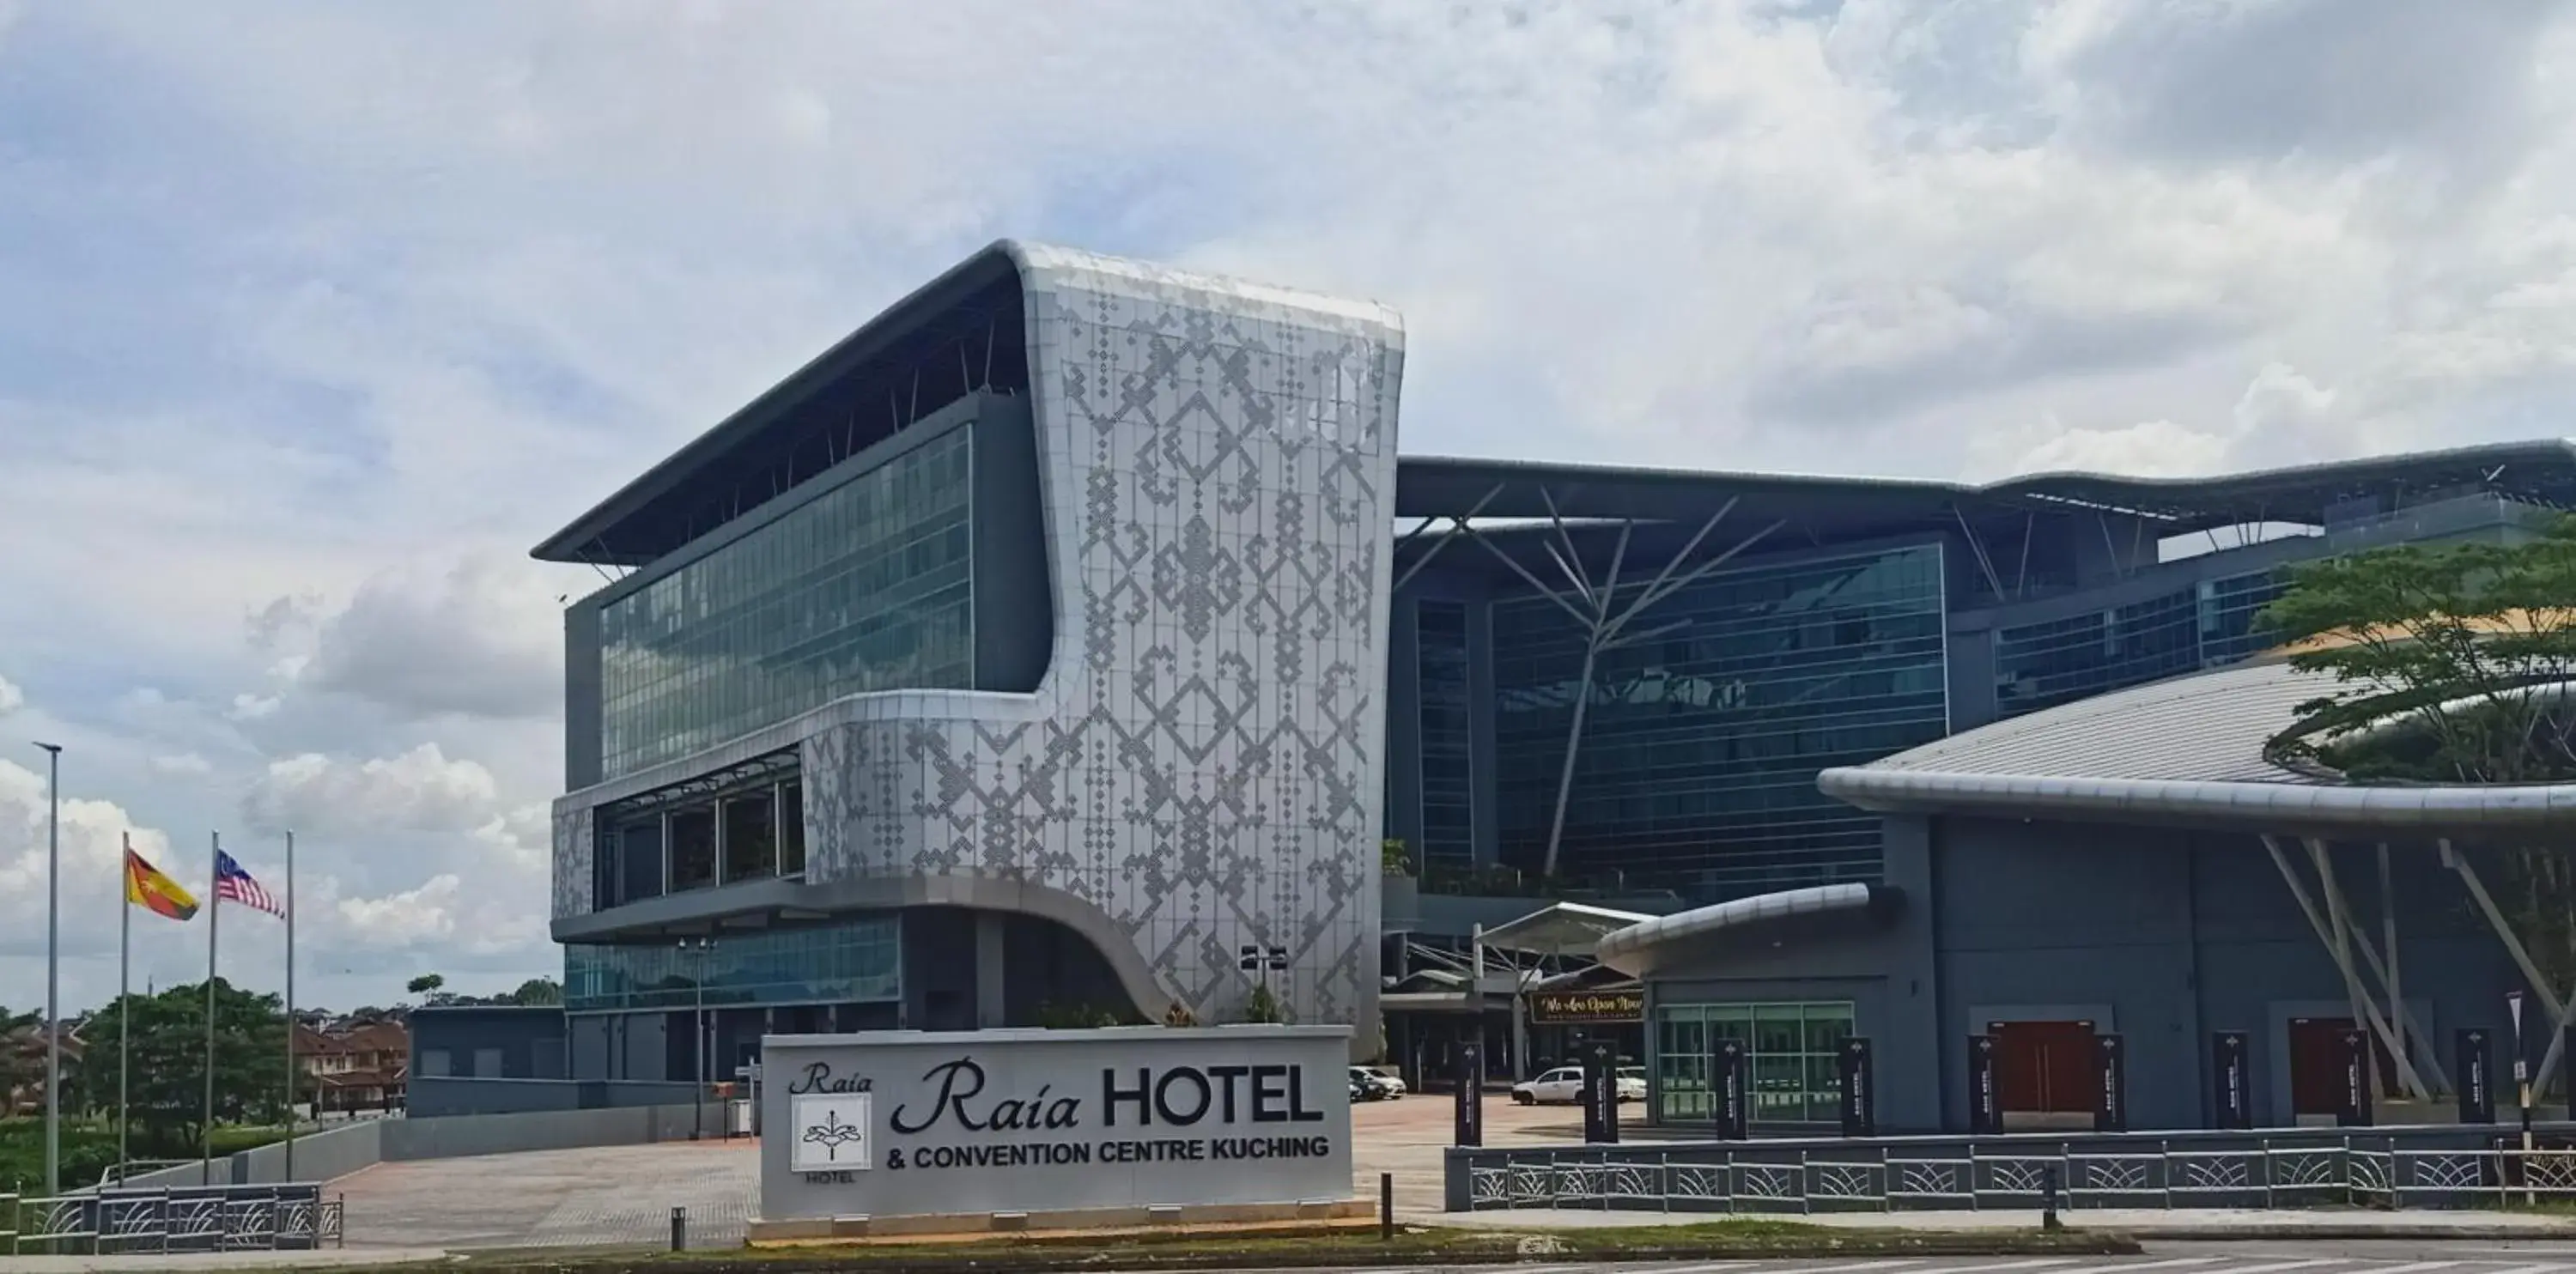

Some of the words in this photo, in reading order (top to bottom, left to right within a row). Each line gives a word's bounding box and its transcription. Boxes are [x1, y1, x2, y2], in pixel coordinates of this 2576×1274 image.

[1103, 1065, 1324, 1127] HOTEL
[887, 1149, 905, 1169] &
[914, 1143, 1091, 1168] CONVENTION
[1099, 1140, 1205, 1162] CENTRE
[1212, 1137, 1329, 1159] KUCHING
[805, 1171, 857, 1184] HOTEL
